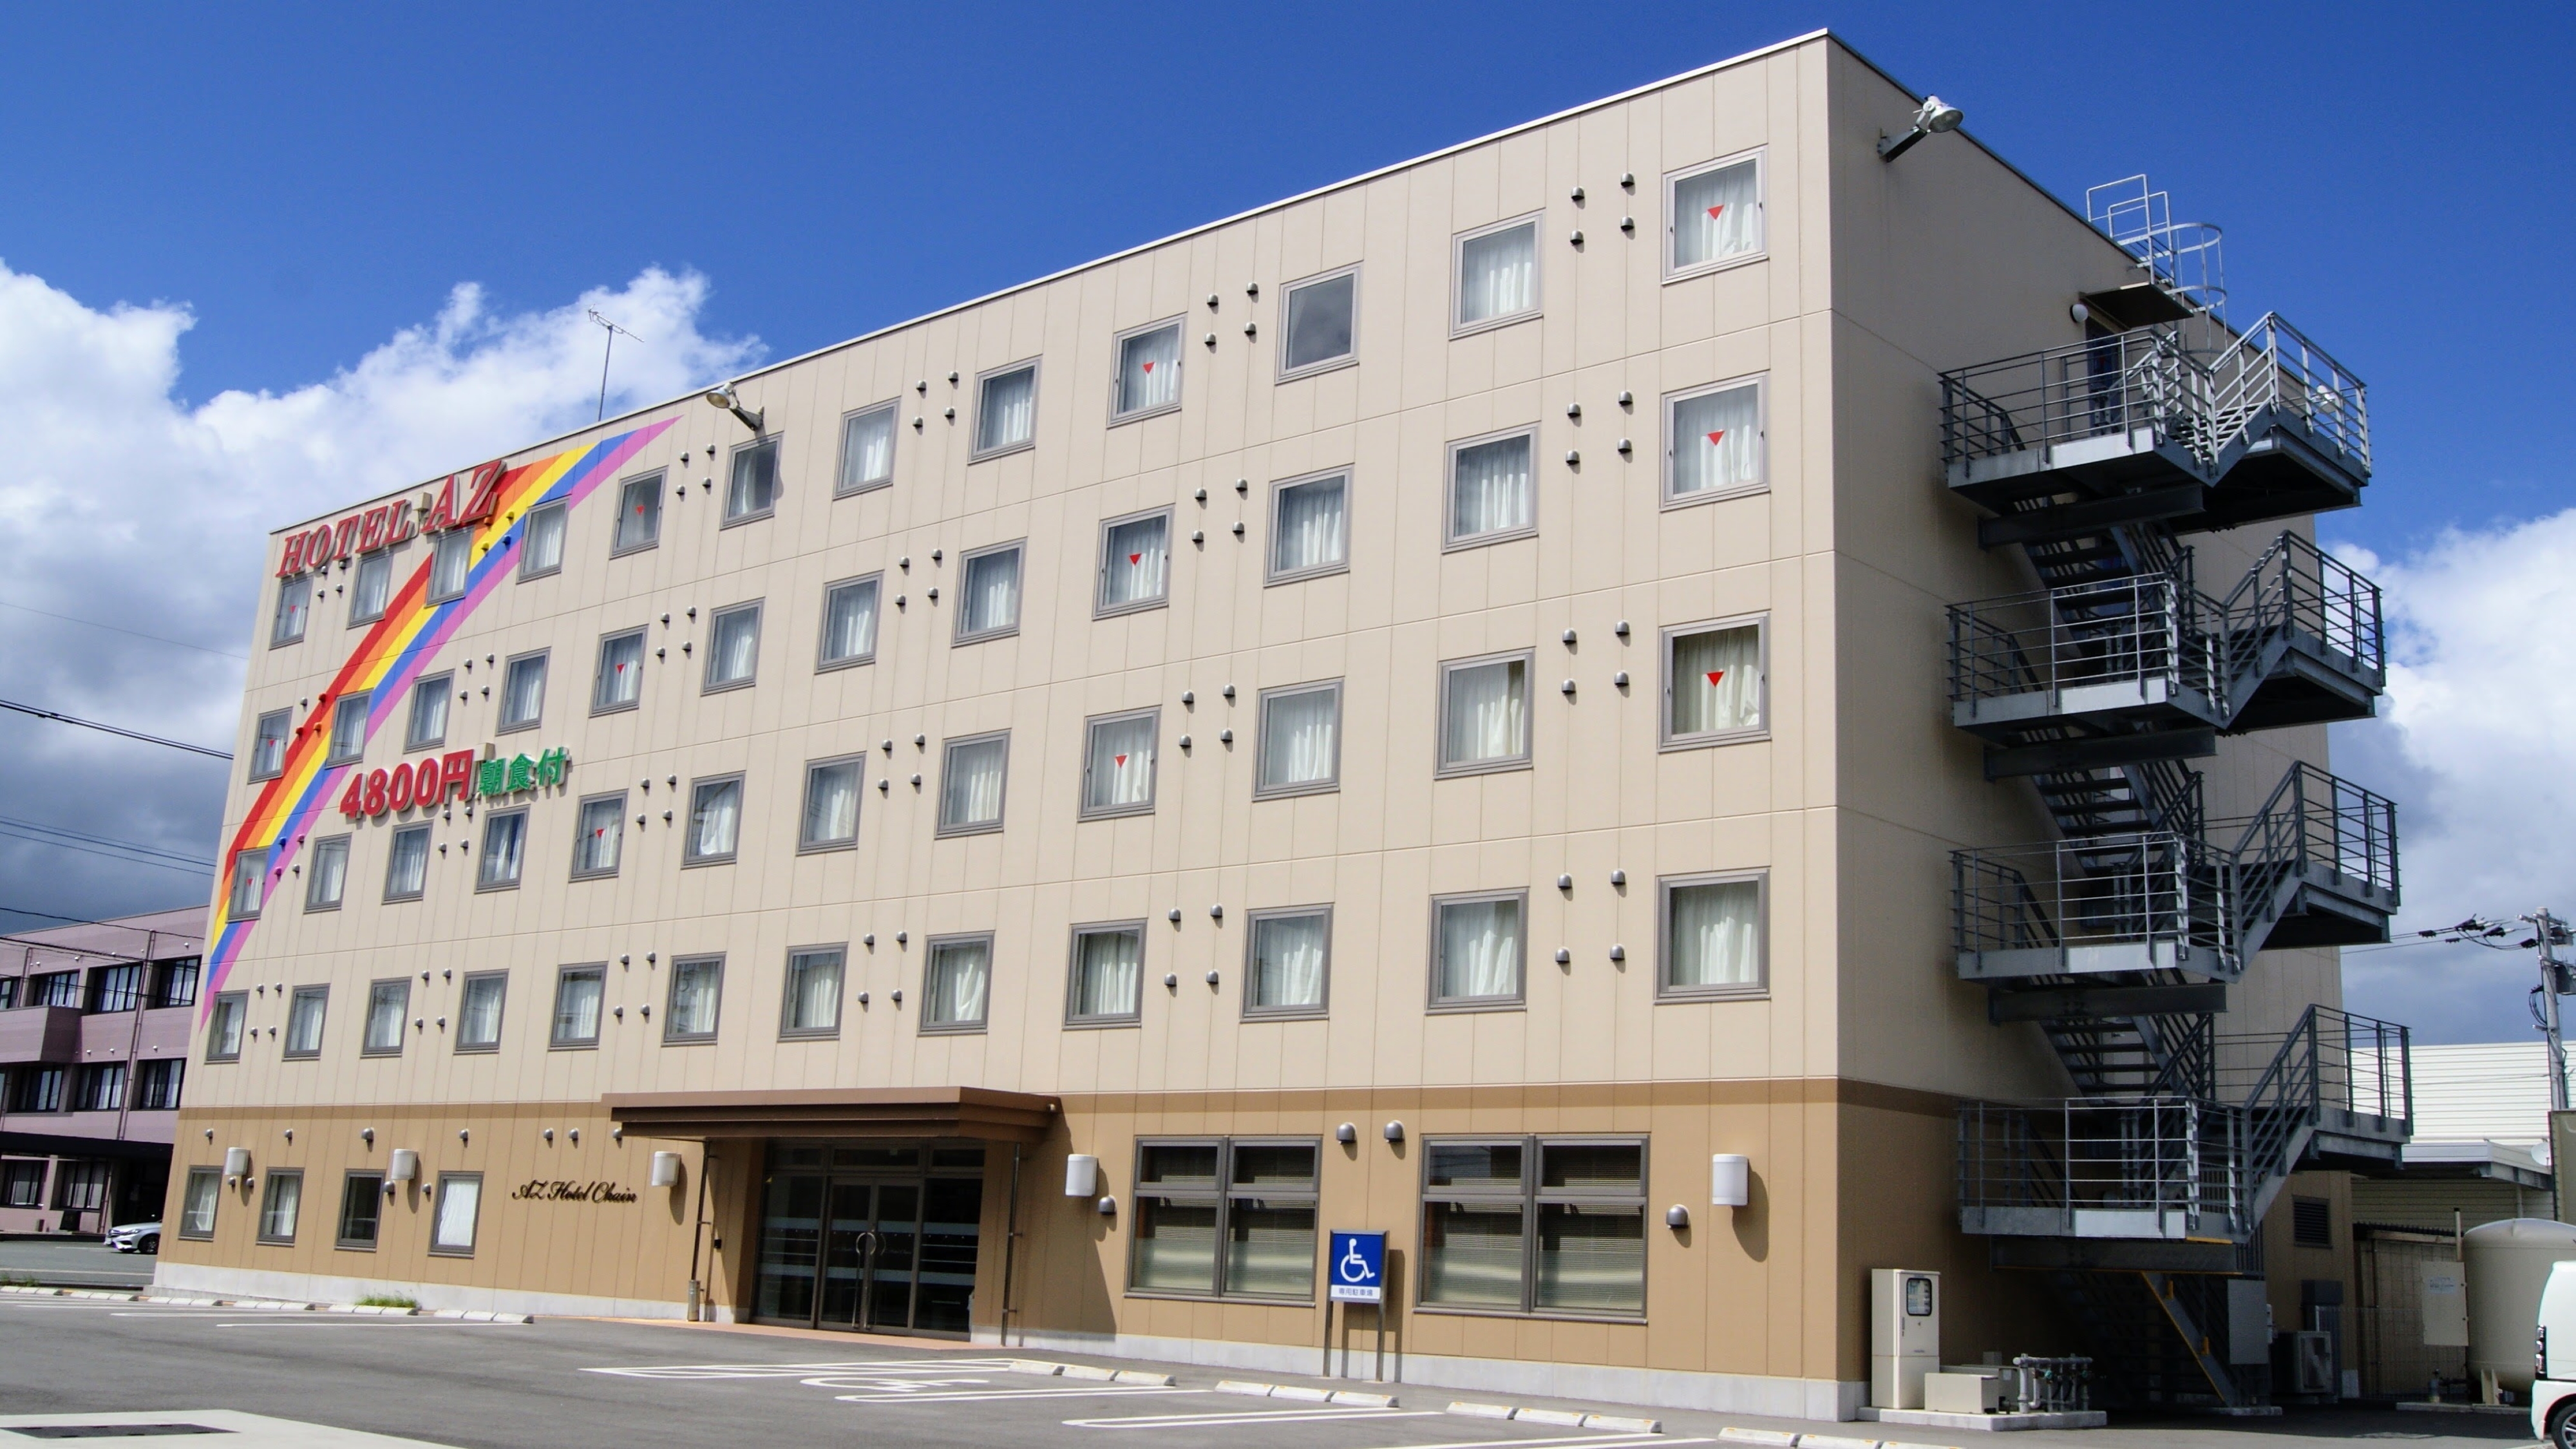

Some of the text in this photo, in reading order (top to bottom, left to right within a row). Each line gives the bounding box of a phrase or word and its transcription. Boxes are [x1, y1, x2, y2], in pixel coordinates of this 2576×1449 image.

[276, 460, 504, 578] HOTEL AZ
[339, 749, 475, 819] 4800円
[512, 1179, 637, 1204] AZ Hotel Chain
